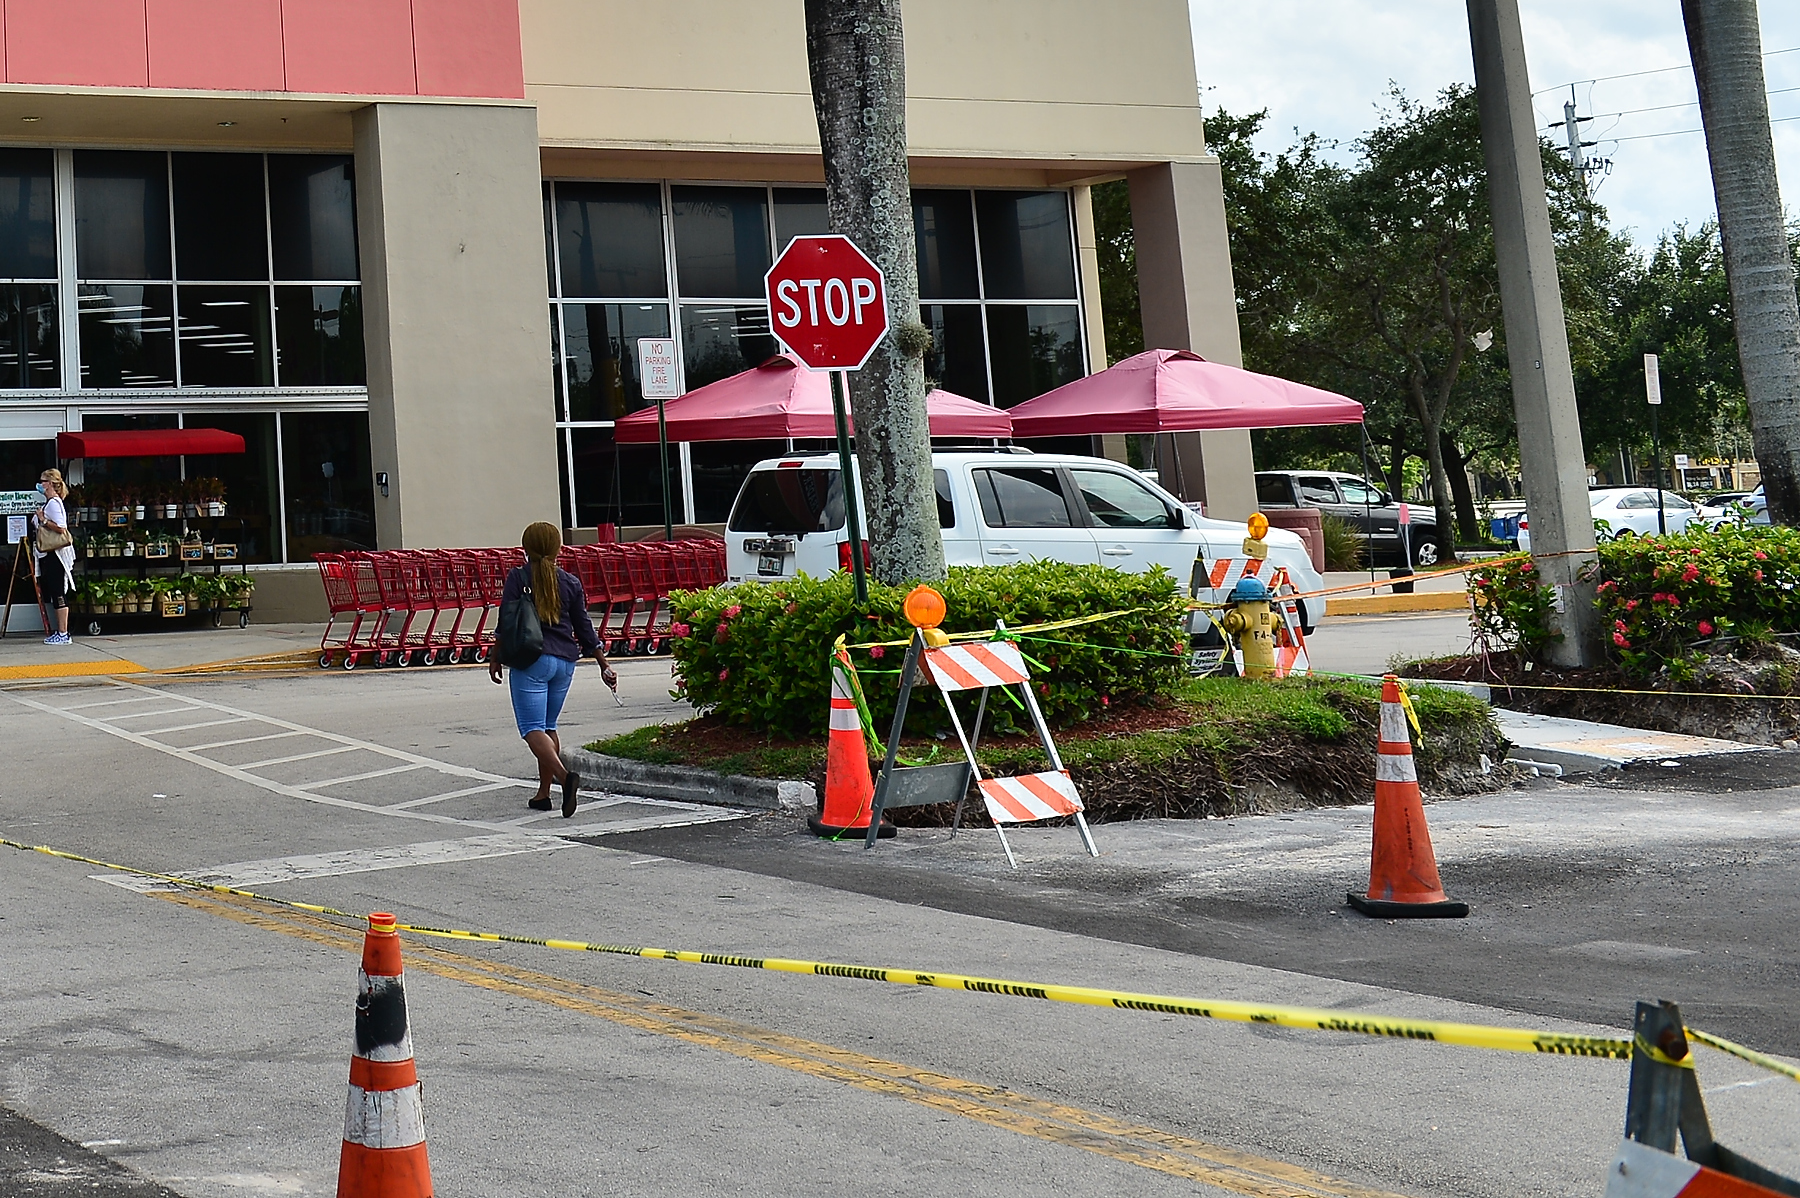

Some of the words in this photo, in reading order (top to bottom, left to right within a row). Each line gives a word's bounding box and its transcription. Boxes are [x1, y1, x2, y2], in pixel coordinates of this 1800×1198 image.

[776, 277, 877, 328] STOP
[651, 343, 663, 355] NO
[645, 356, 672, 365] PARKING
[652, 366, 666, 375] FIRE
[651, 375, 668, 384] LANE
